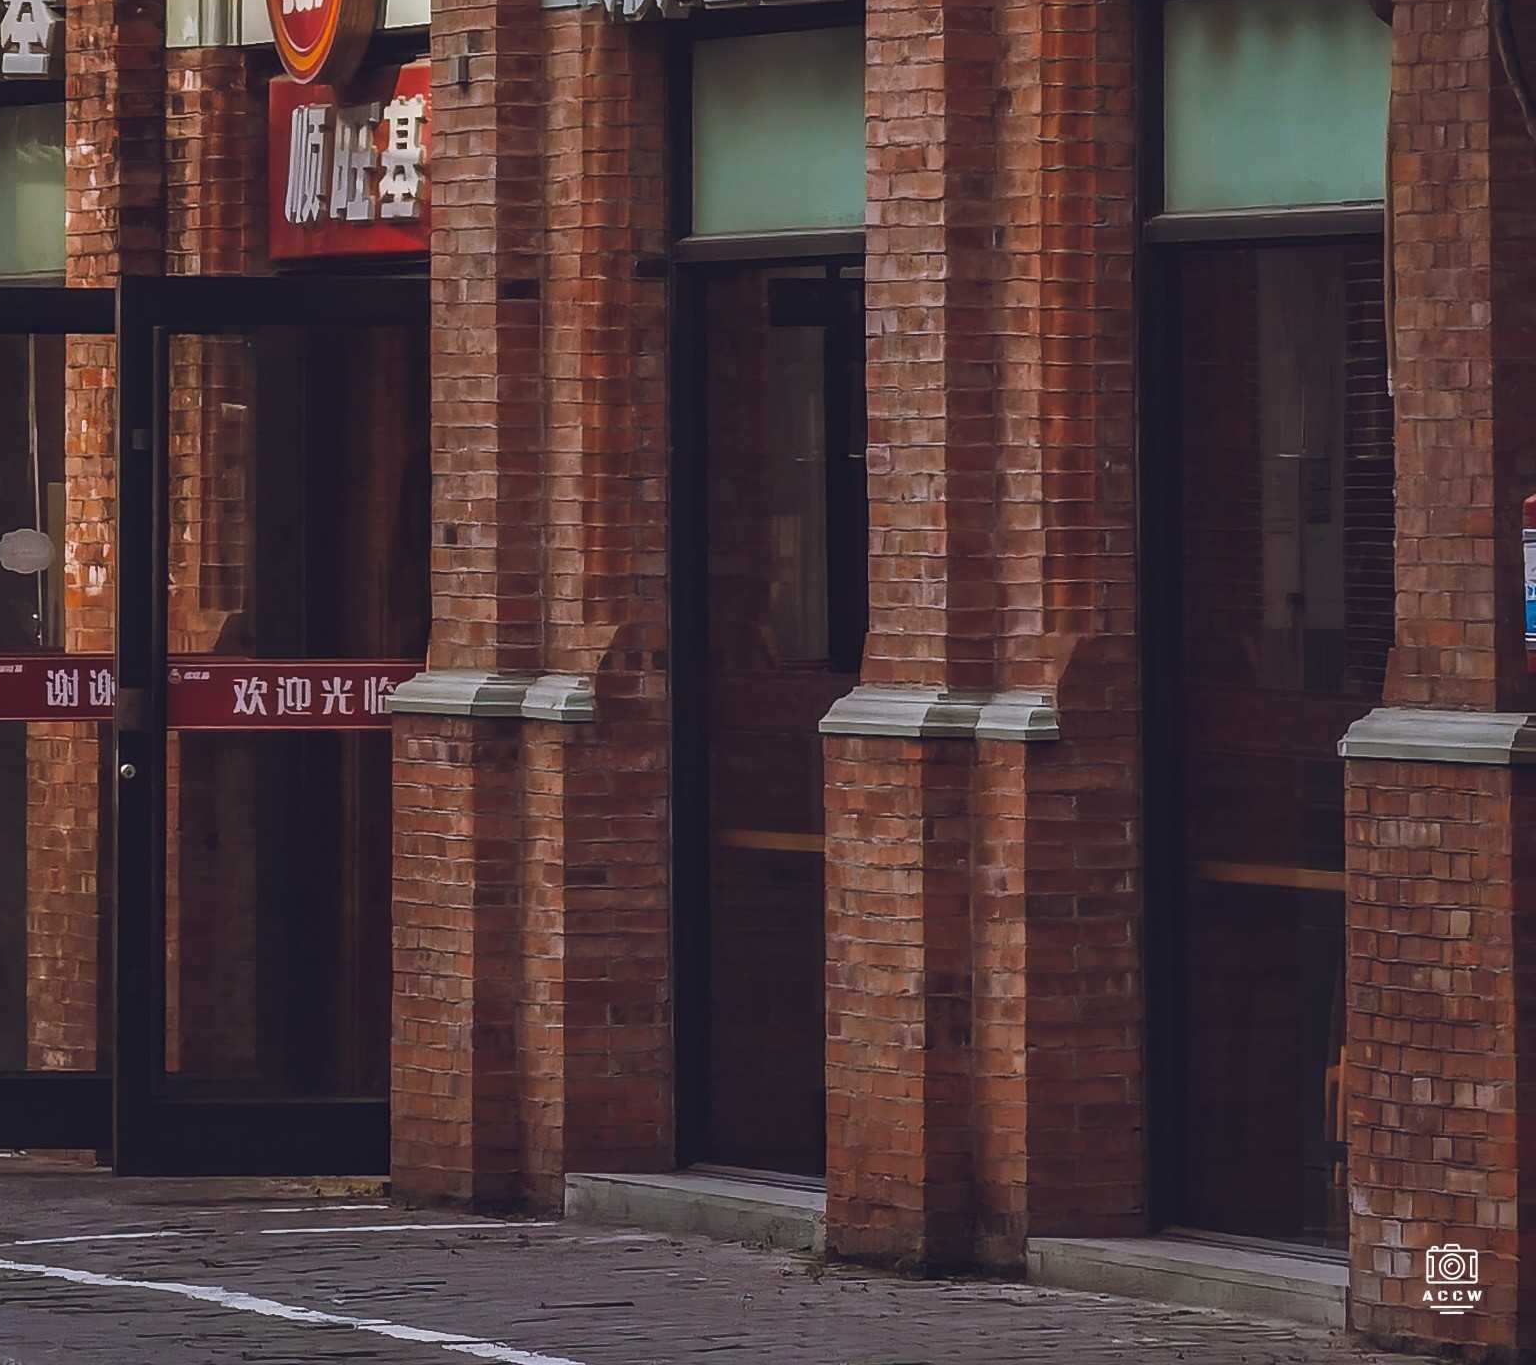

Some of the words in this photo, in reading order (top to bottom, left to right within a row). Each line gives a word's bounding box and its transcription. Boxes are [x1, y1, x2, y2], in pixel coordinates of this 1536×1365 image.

[284, 94, 427, 224] 顺旺基
[232, 676, 397, 716] 欢迎光临
